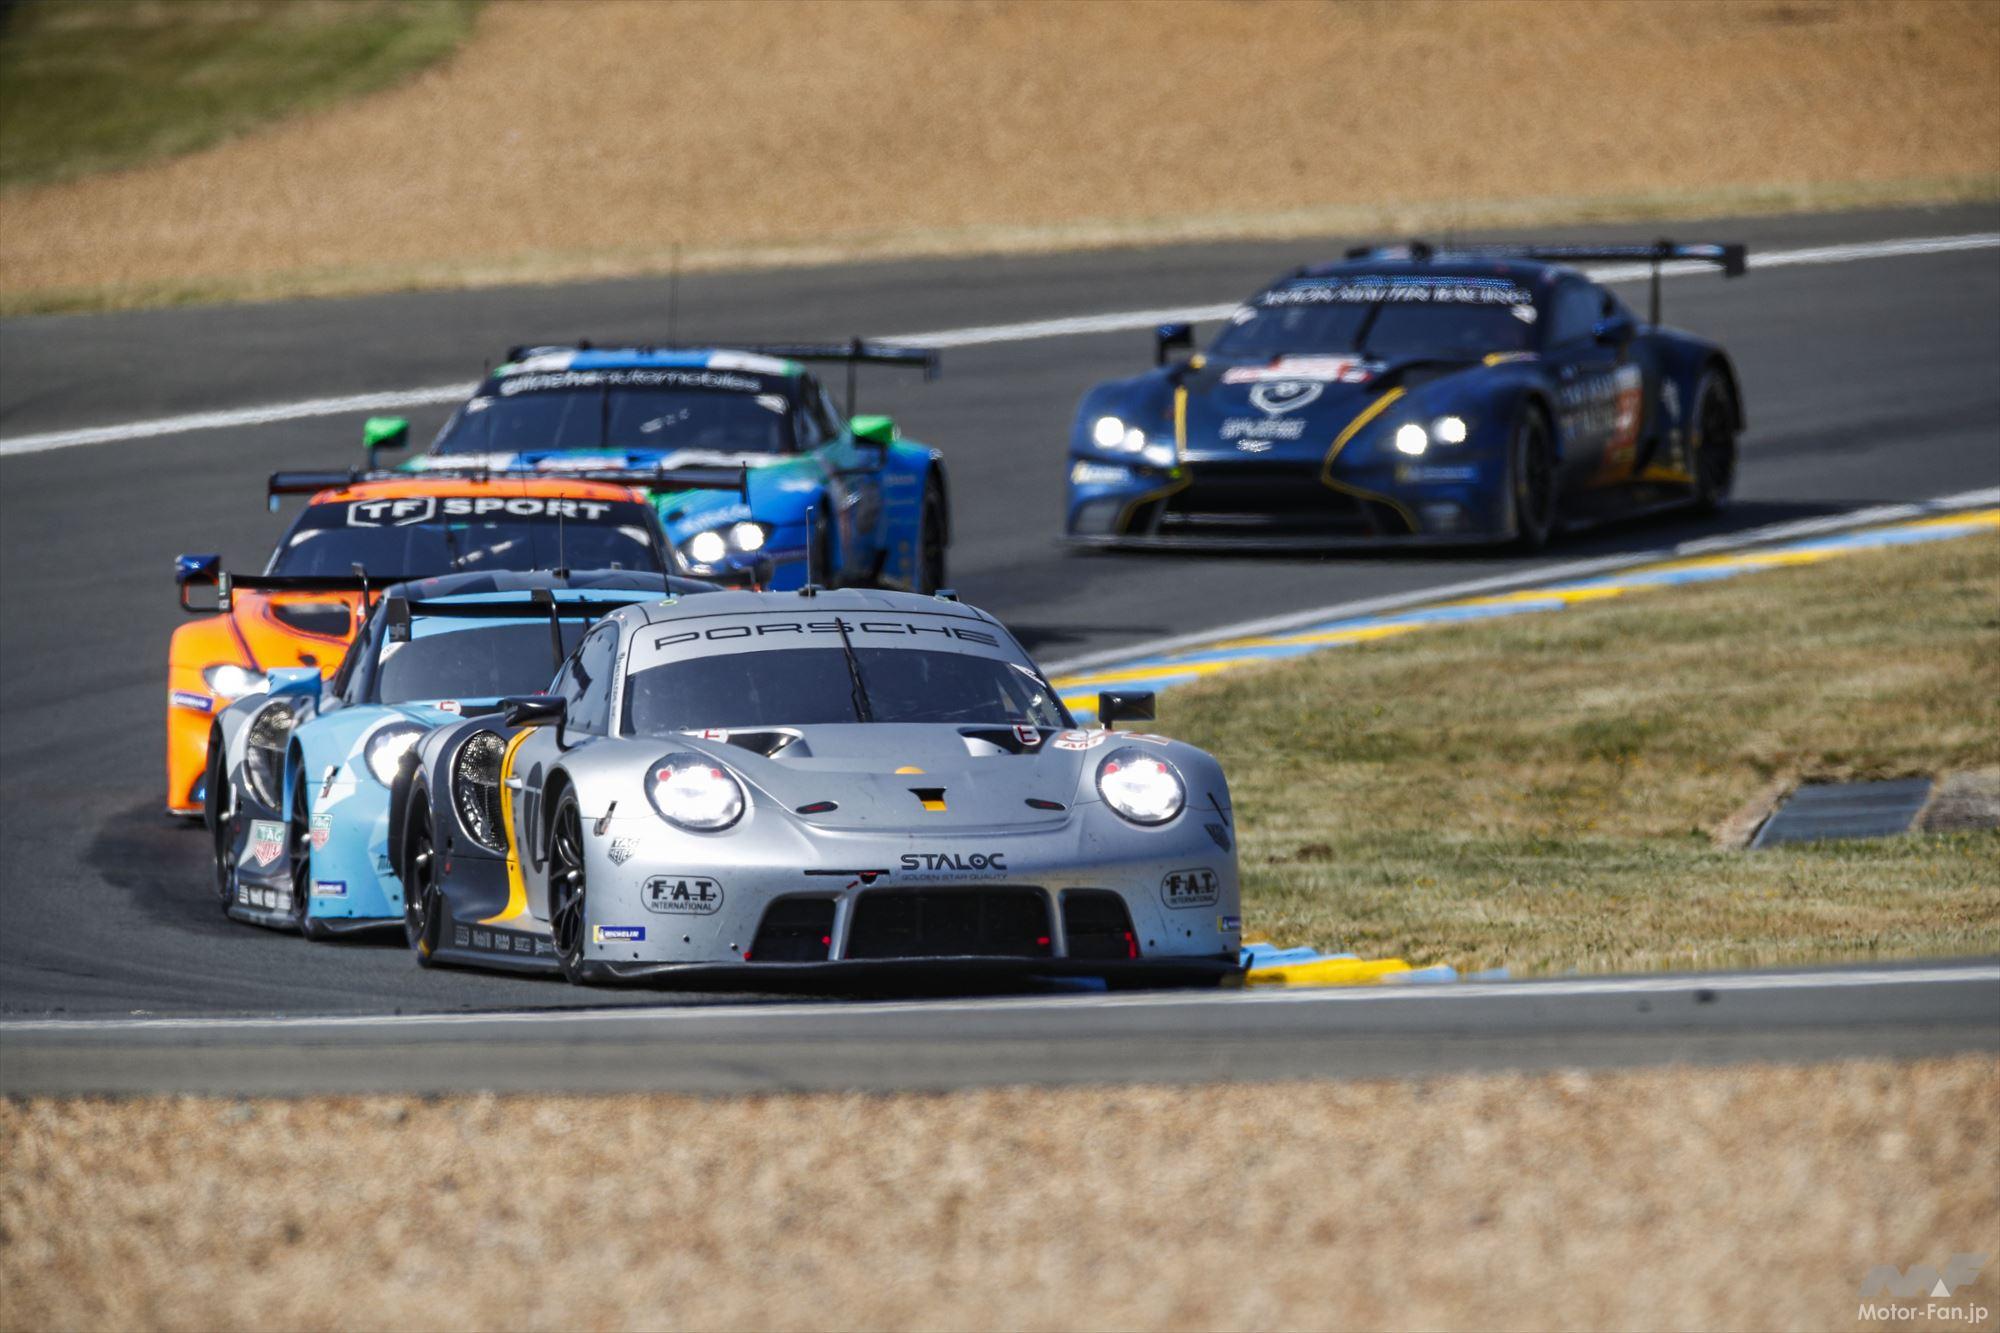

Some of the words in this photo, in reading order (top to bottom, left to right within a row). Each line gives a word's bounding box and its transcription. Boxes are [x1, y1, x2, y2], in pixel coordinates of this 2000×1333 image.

[361, 501, 423, 519] TF
[443, 498, 611, 520] SPORT
[654, 622, 1000, 651] PORSCHE
[260, 826, 284, 843] TAG
[612, 838, 640, 848] TAG
[900, 853, 1008, 871] STALOC
[902, 873, 940, 881] GOLDEN
[942, 873, 968, 881] STAR
[651, 901, 713, 911] INTERNATIONAL
